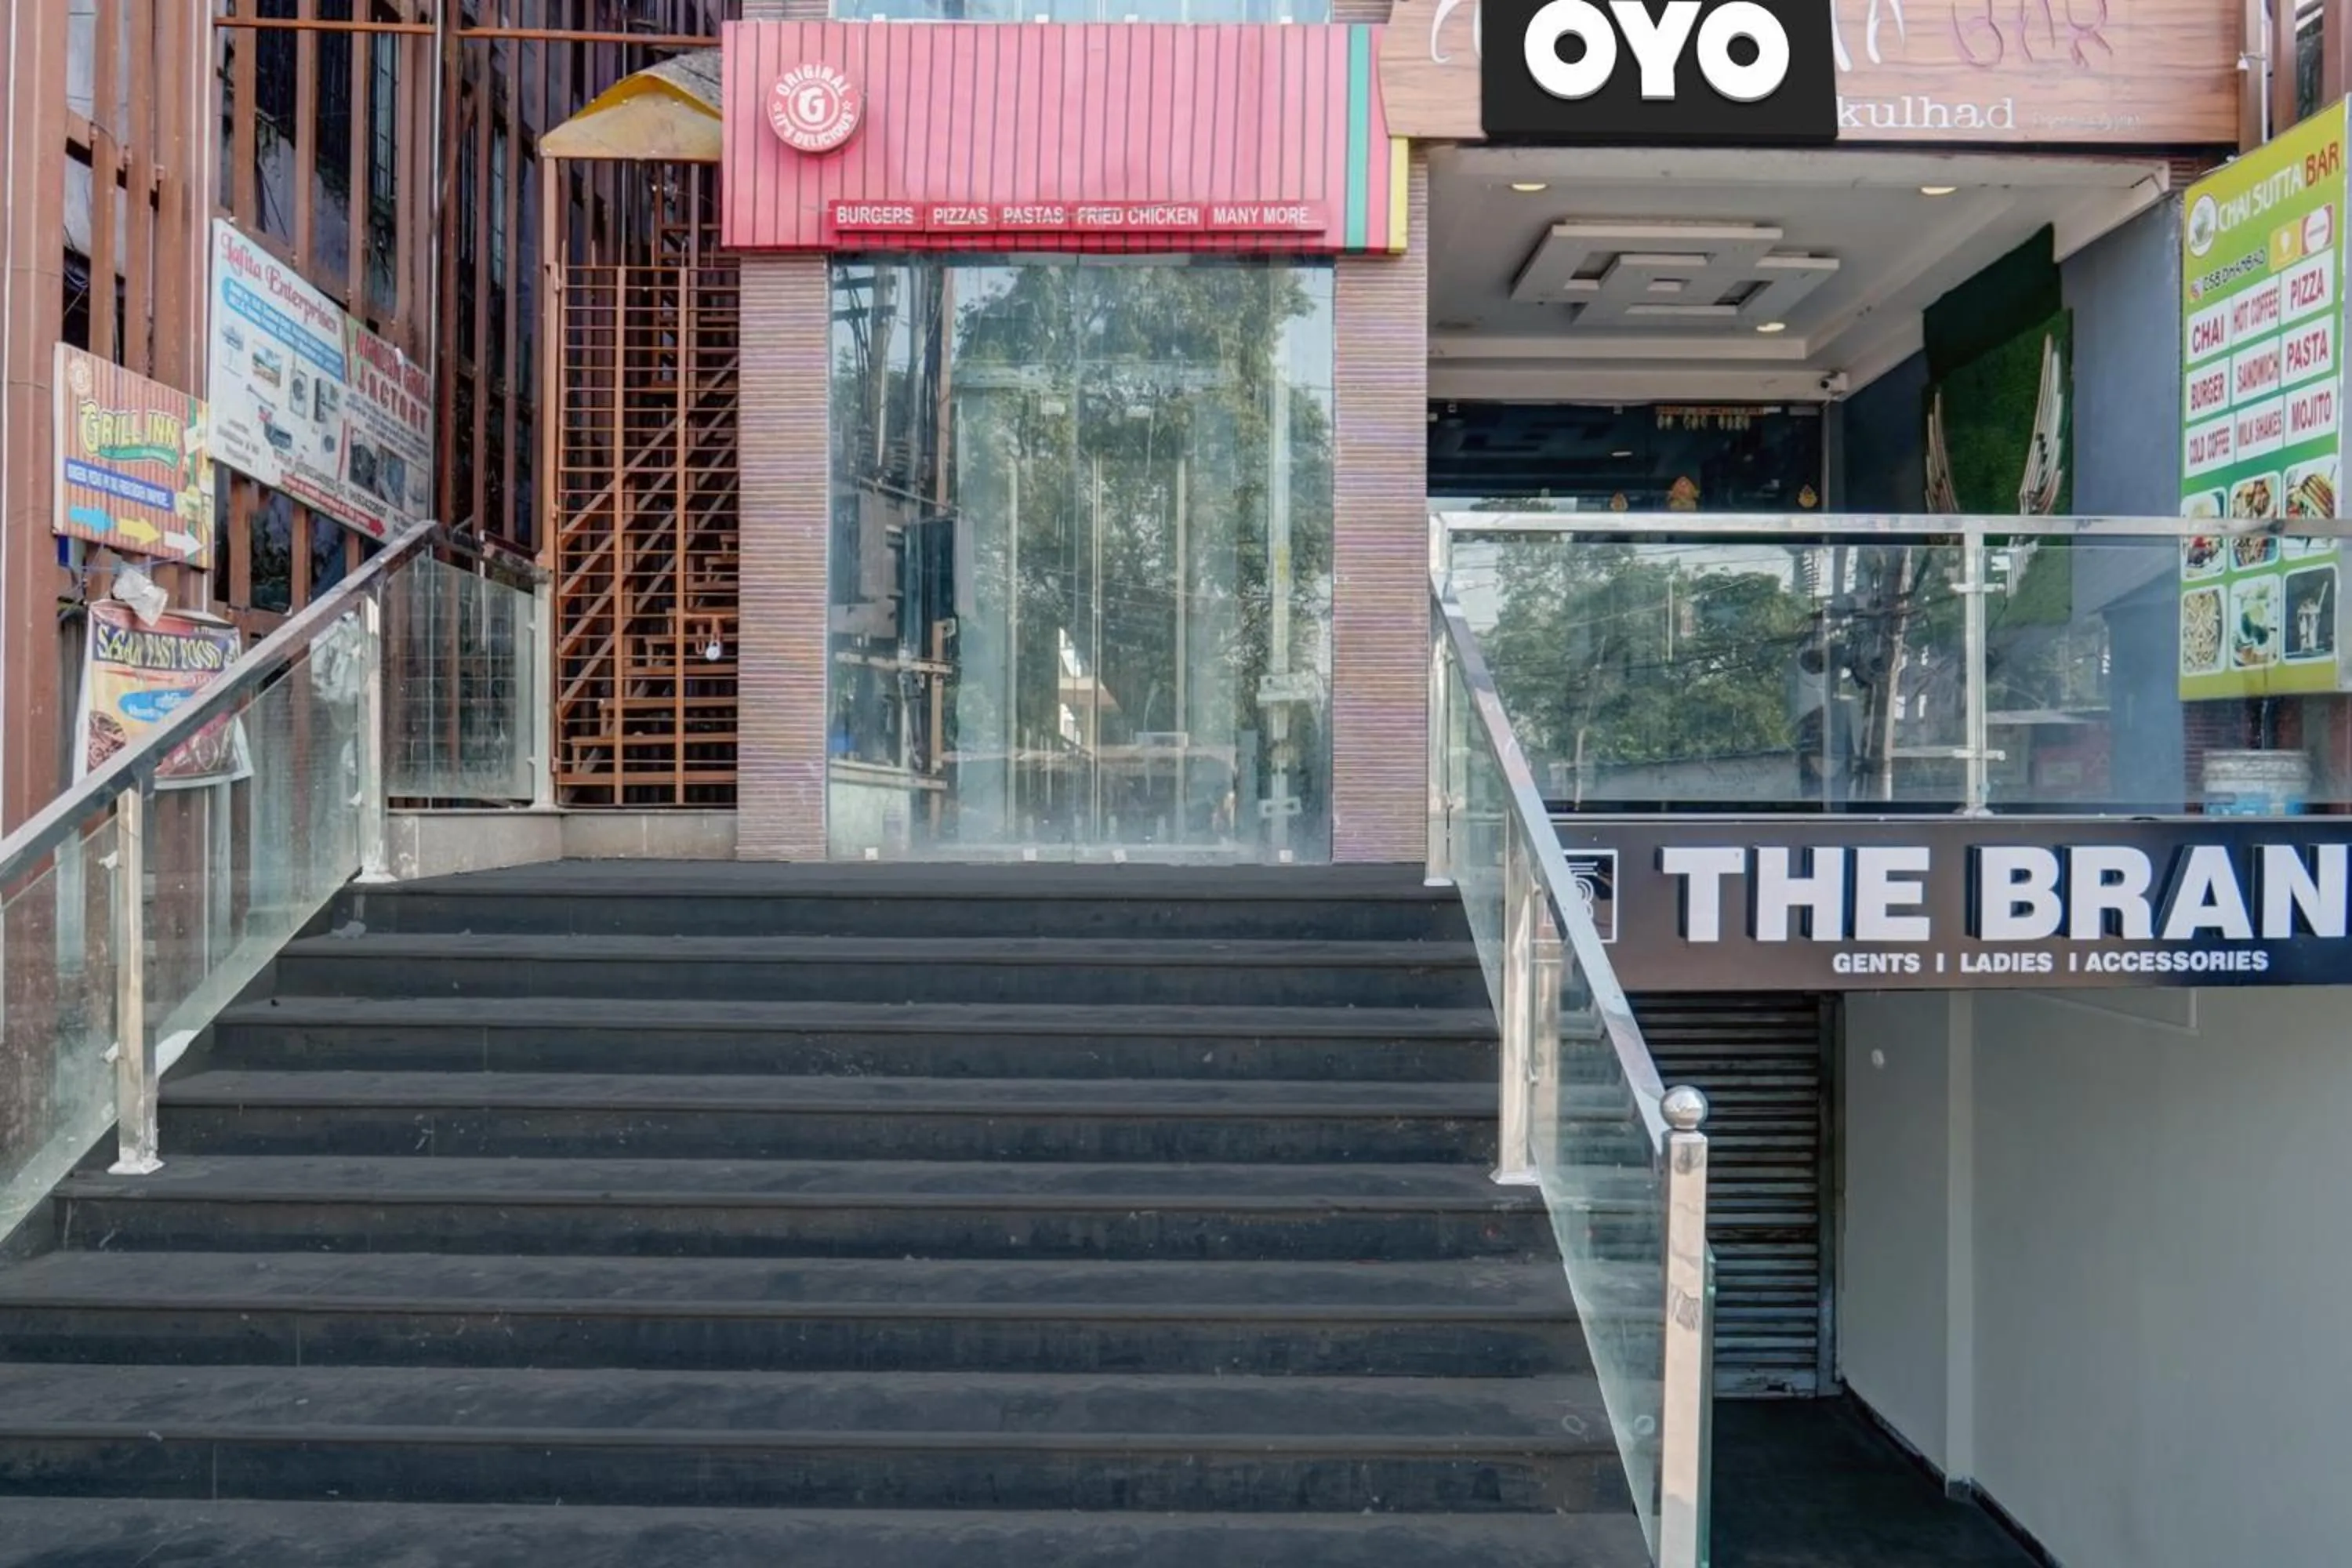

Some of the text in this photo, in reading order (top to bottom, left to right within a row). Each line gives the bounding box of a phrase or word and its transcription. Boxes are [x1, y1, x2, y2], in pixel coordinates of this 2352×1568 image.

[1524, 0, 1790, 102] OYO
[776, 63, 851, 96] ORIGINAL
[798, 87, 826, 123] G
[1837, 96, 2015, 129] kulhad
[793, 111, 855, 147] DELICIOUS
[2218, 142, 2340, 232] CHAI SUTTA BAR
[836, 206, 914, 225] BURGERS
[933, 207, 989, 226] PIZZAS
[1003, 206, 1065, 225] PASTAS
[1077, 206, 1200, 226] FRIED CHICKEN
[1213, 207, 1261, 226] MANY
[2250, 288, 2278, 327] COFFEE
[2290, 267, 2325, 311] PIZZA
[2192, 314, 2225, 354] CHAI
[2287, 328, 2328, 374] PASTA
[2237, 350, 2280, 393] SANDWICH
[2190, 372, 2224, 412] BURGER
[2291, 390, 2332, 433] MOJITO
[80, 401, 143, 454] GRILL
[147, 409, 180, 449] INN
[2256, 409, 2282, 442] SHAKES
[2189, 426, 2230, 465] COLD COFFEE
[1662, 844, 2347, 942] THE BRAN
[1832, 953, 1920, 973] GENTS
[1960, 952, 2053, 972] LADIES
[2085, 950, 2270, 972] ACCESSORIES
